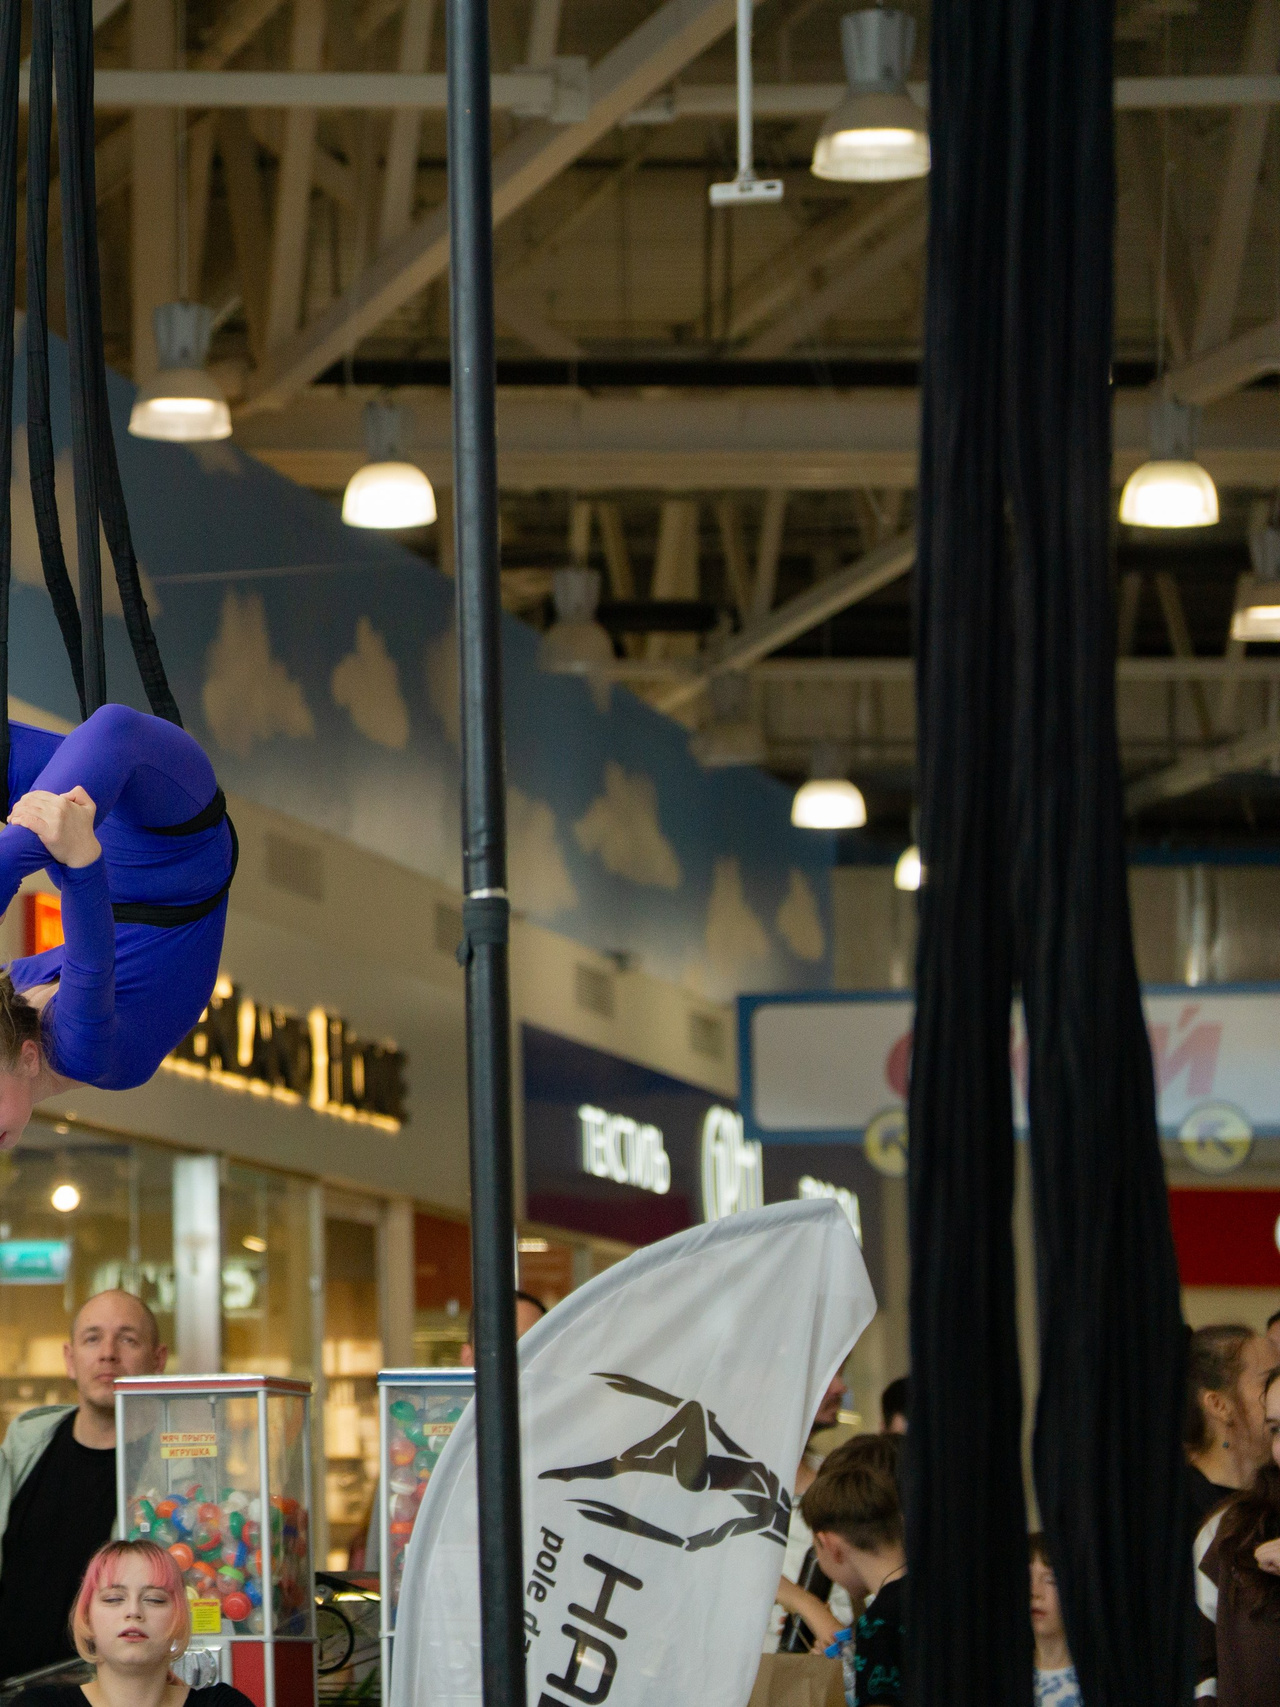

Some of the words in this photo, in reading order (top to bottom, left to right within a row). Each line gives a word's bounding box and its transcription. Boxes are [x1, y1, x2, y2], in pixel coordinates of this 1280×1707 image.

[432, 1425, 454, 1434] ИГРУ
[162, 1434, 179, 1442] МЯЧ
[182, 1433, 215, 1442] ПРЫГУН
[169, 1447, 210, 1457] ИГРУШКА
[525, 1526, 565, 1603] pole
[537, 1553, 644, 1707] HA
